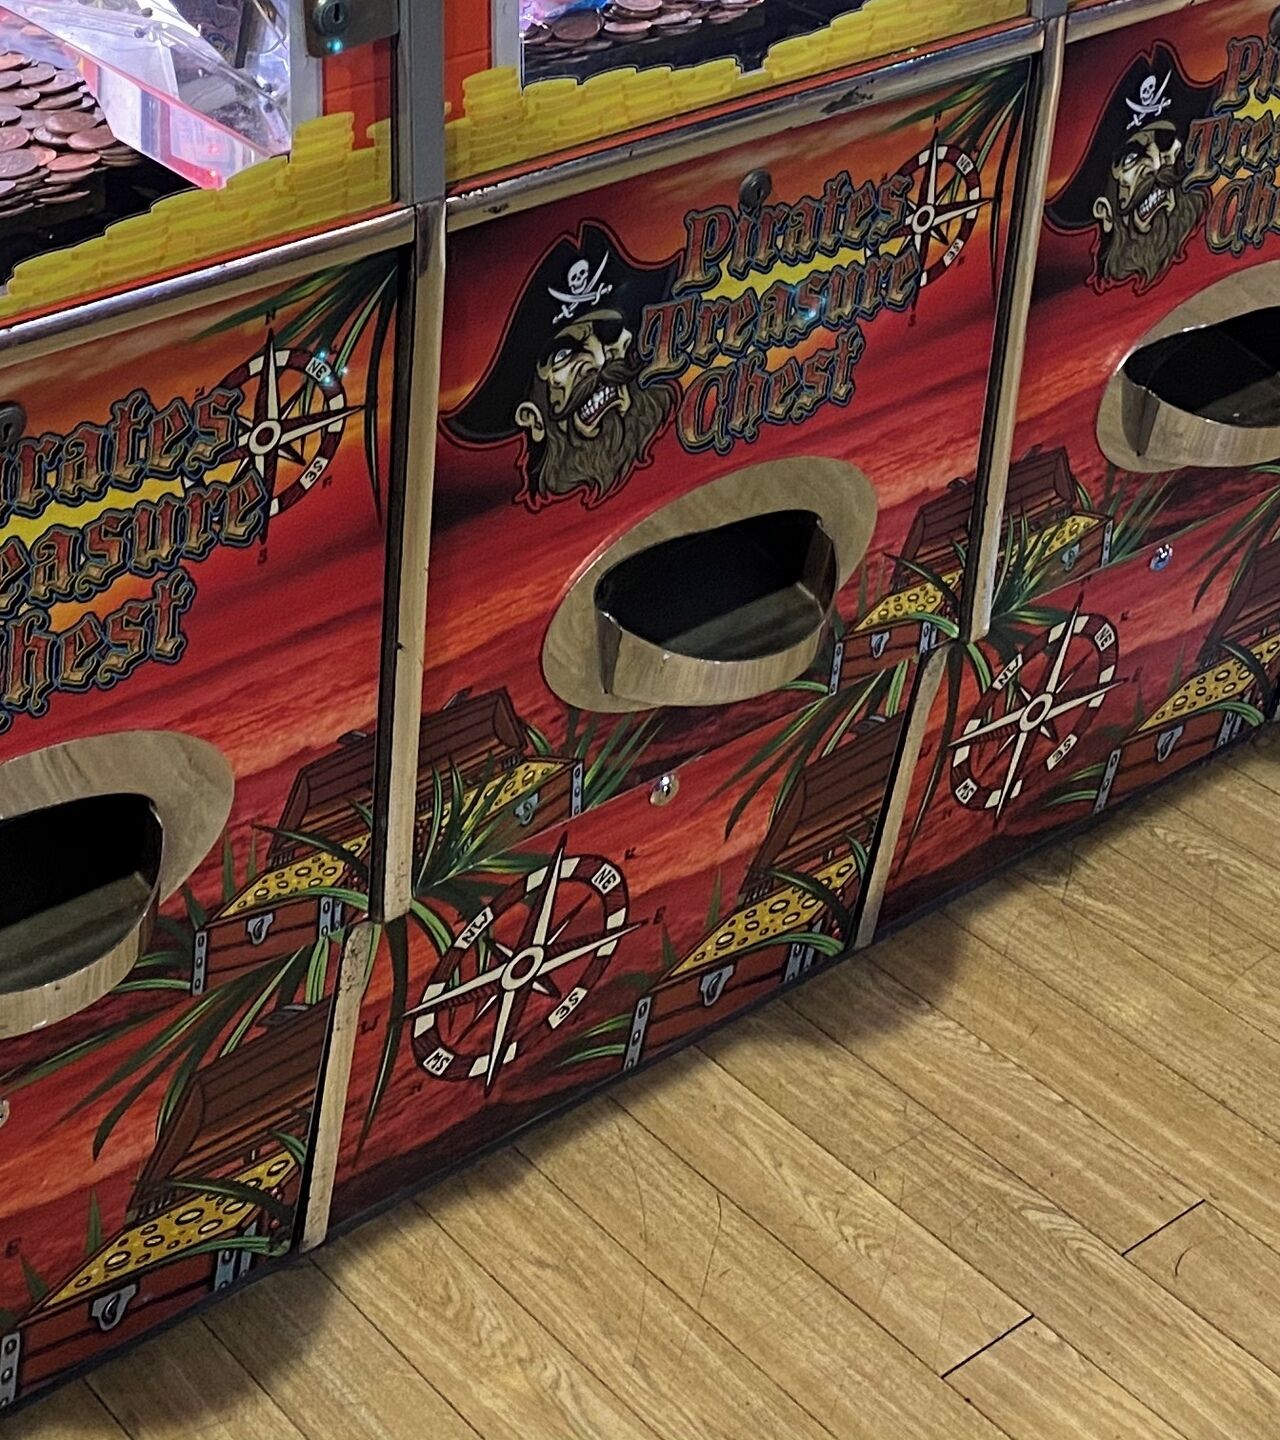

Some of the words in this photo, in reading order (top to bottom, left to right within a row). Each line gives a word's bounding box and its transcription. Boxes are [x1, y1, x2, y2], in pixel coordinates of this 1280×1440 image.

[672, 170, 916, 297] Pirates
[638, 244, 922, 387] Treasure
[675, 324, 866, 456] Chest
